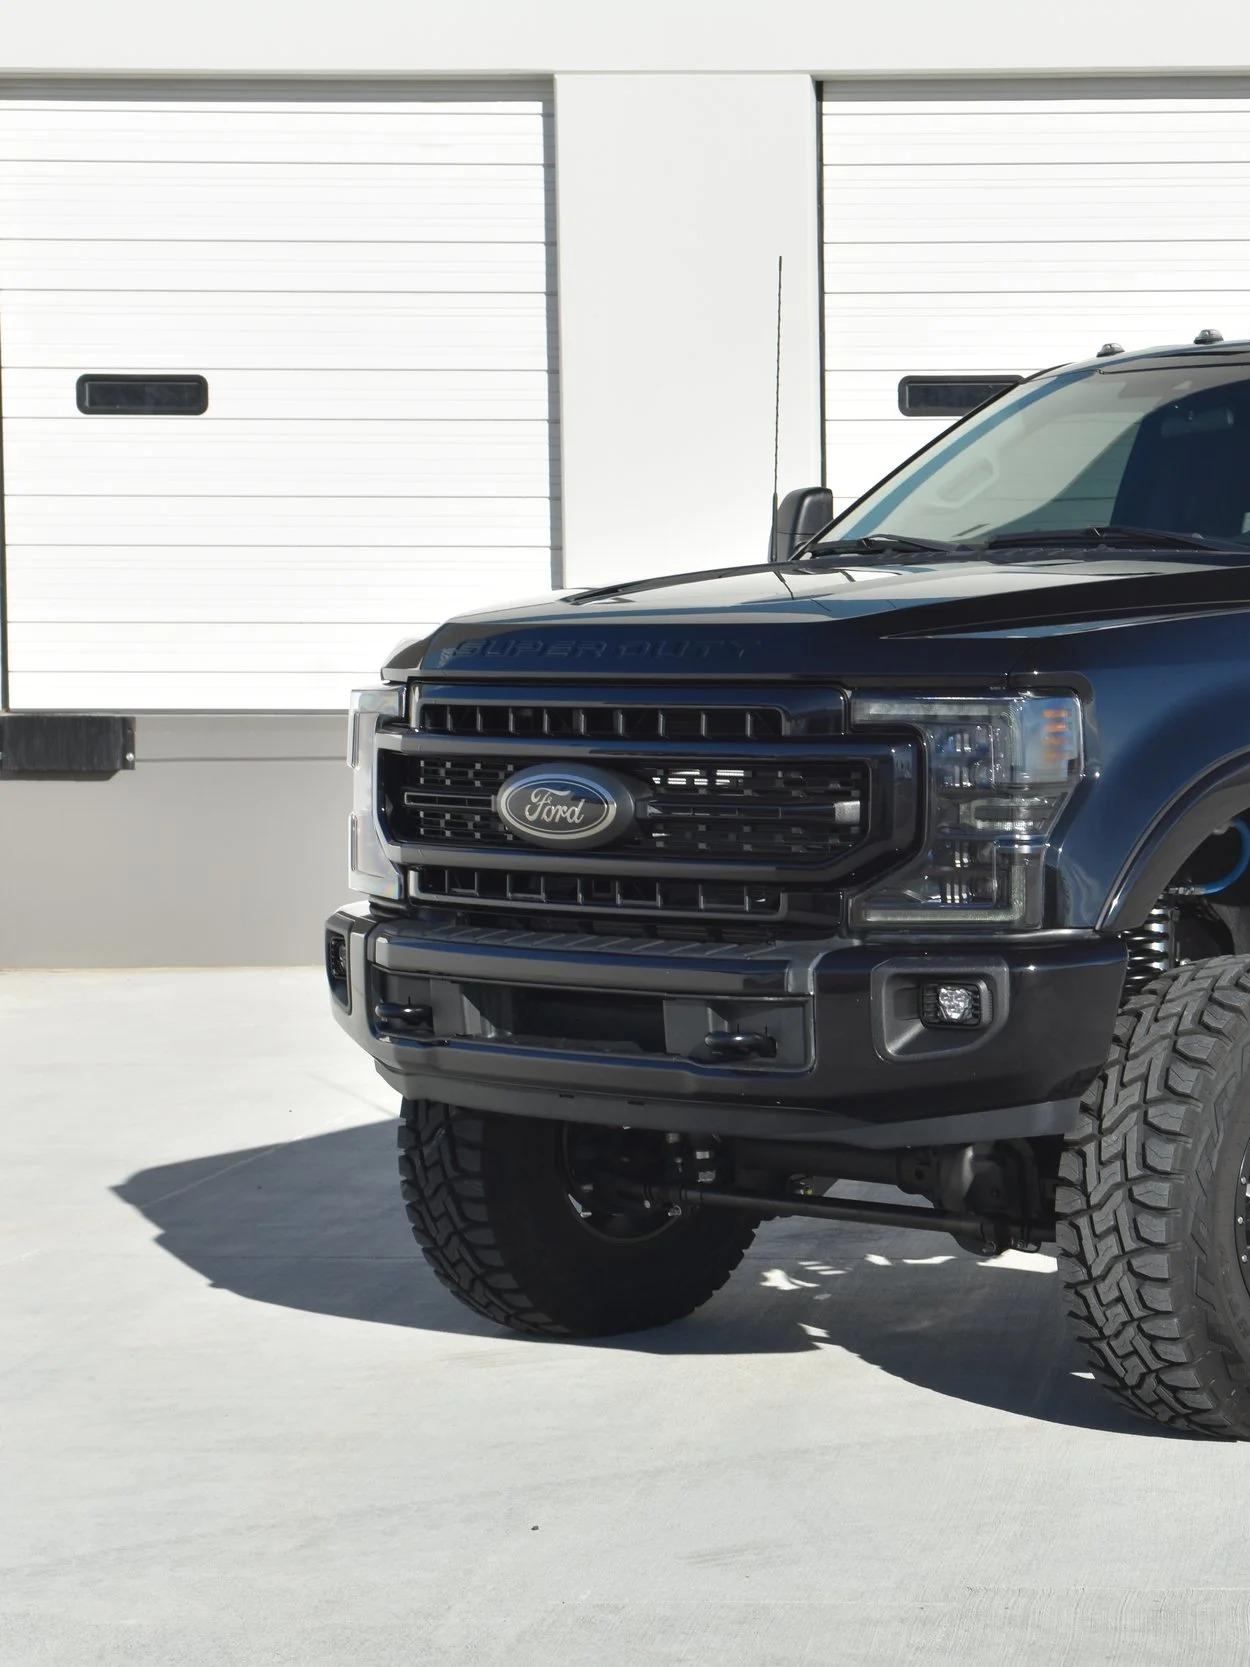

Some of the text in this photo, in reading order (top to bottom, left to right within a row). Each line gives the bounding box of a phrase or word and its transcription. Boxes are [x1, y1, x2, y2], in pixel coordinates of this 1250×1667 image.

[454, 639, 762, 659] SUPER DUTY
[525, 787, 585, 823] Ford
